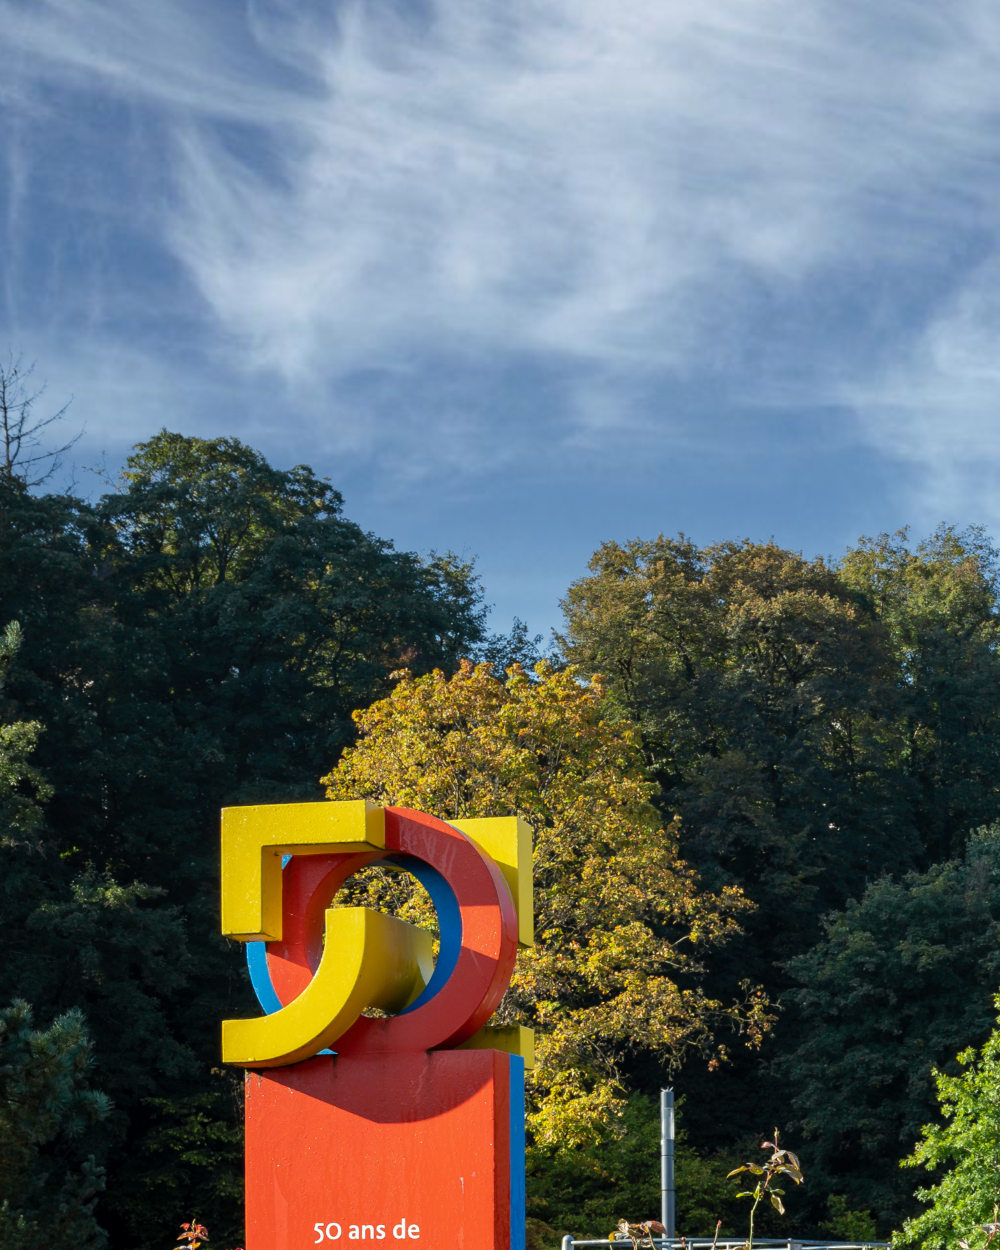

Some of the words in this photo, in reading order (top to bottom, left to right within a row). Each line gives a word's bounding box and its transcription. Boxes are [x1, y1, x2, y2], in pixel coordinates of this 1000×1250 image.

[313, 1222, 342, 1244] 50
[348, 1224, 386, 1240] ans
[392, 1218, 420, 1240] de
